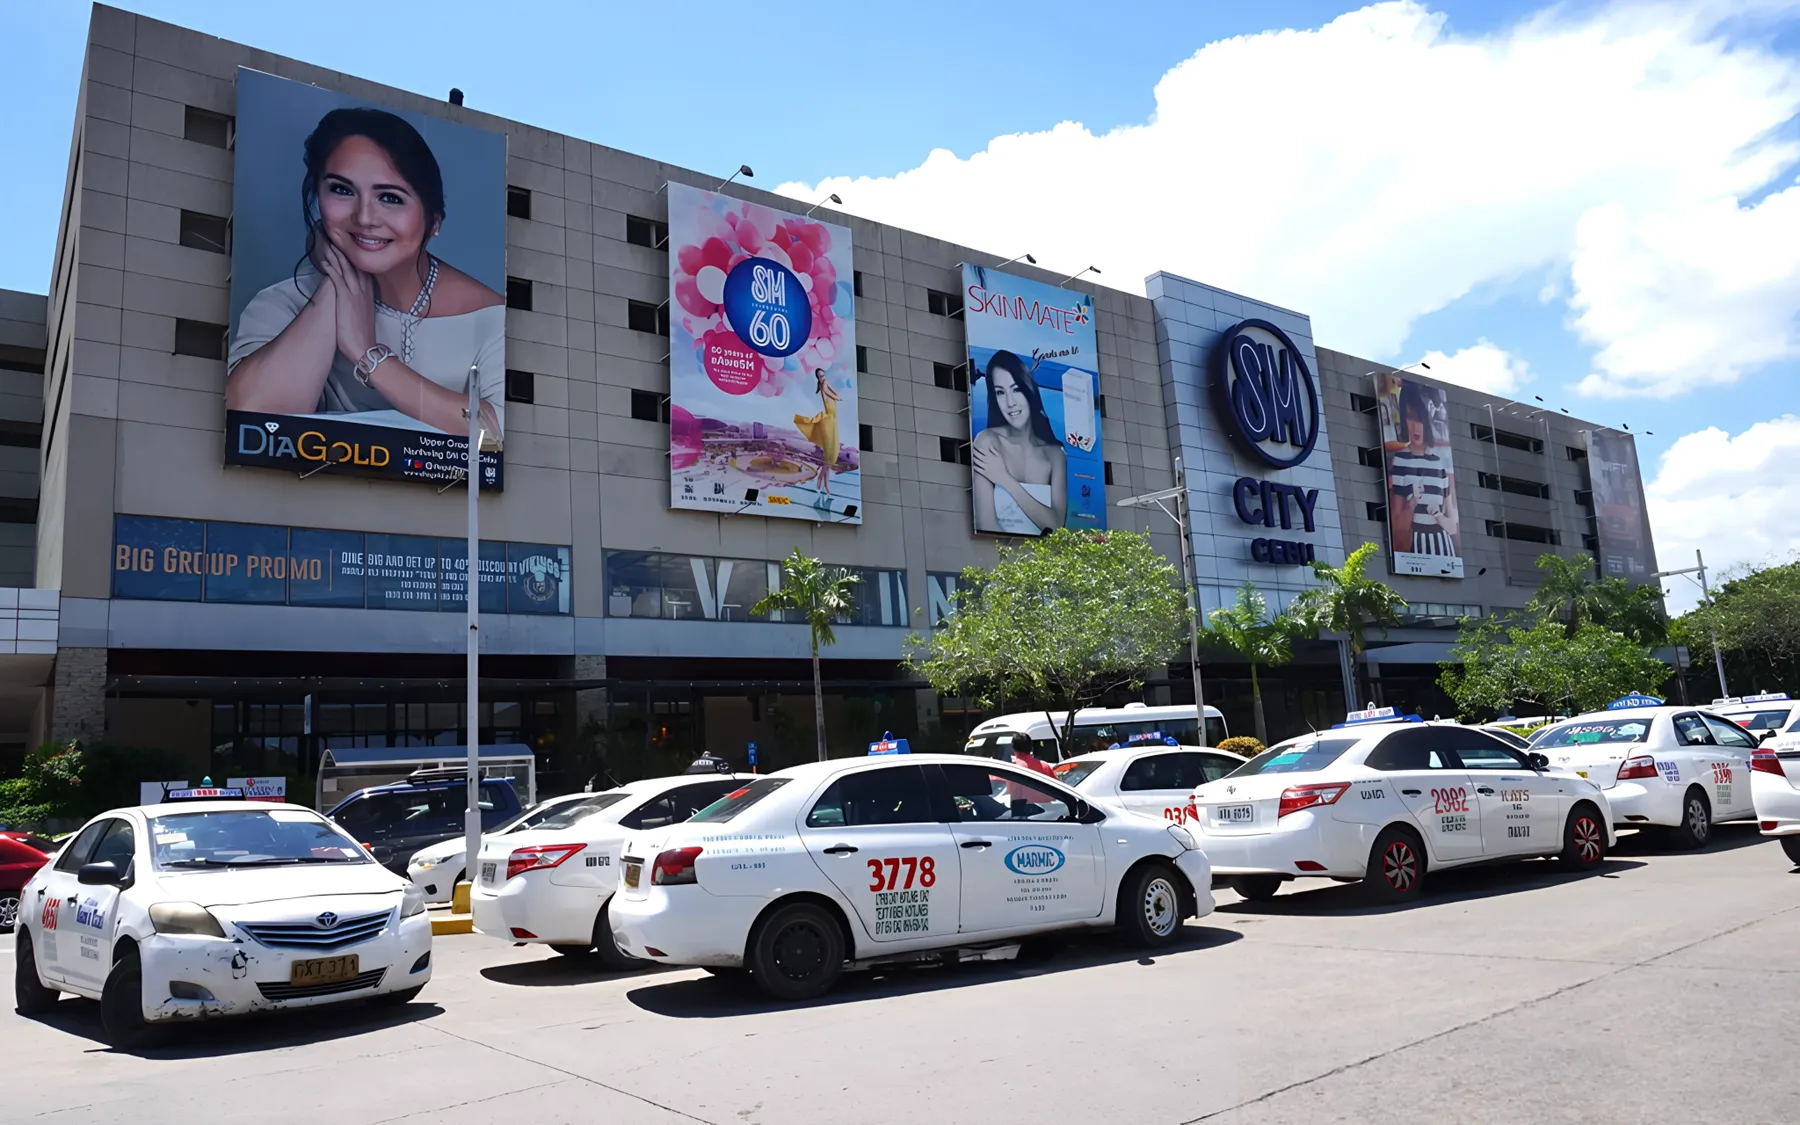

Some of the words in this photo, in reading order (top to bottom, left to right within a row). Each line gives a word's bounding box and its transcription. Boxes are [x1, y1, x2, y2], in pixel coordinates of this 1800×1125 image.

[751, 264, 787, 307] SM
[968, 284, 1075, 334] SKINMATE
[749, 312, 791, 351] 60
[1230, 334, 1307, 447] SM
[1233, 477, 1319, 532] CITY
[163, 547, 239, 577] GROUP
[246, 555, 322, 581] PROMO
[1251, 537, 1316, 567] CEBU
[867, 856, 936, 893] 3778
